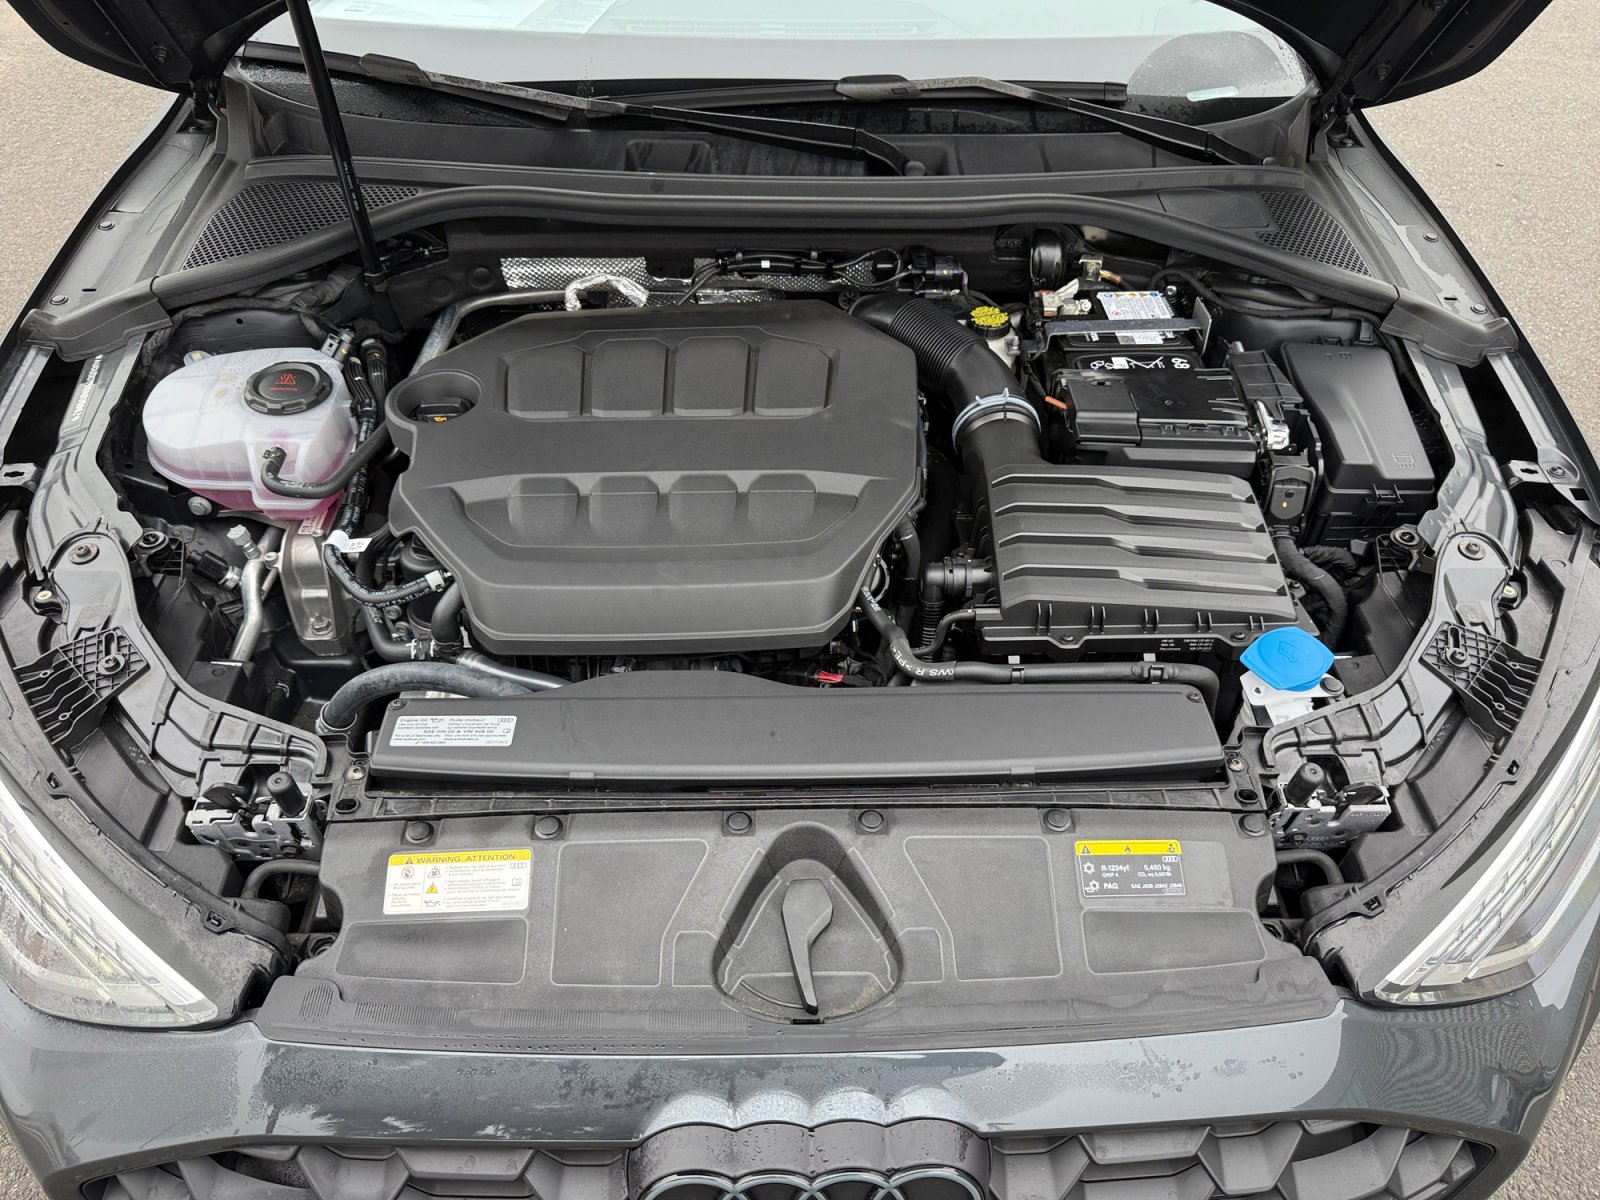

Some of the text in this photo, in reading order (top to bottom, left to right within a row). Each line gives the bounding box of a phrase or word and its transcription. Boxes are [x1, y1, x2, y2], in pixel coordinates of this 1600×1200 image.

[416, 853, 516, 864] WARNING ATTENTION
[1100, 864, 1130, 873] R-1234yf
[1162, 864, 1171, 872] kg
